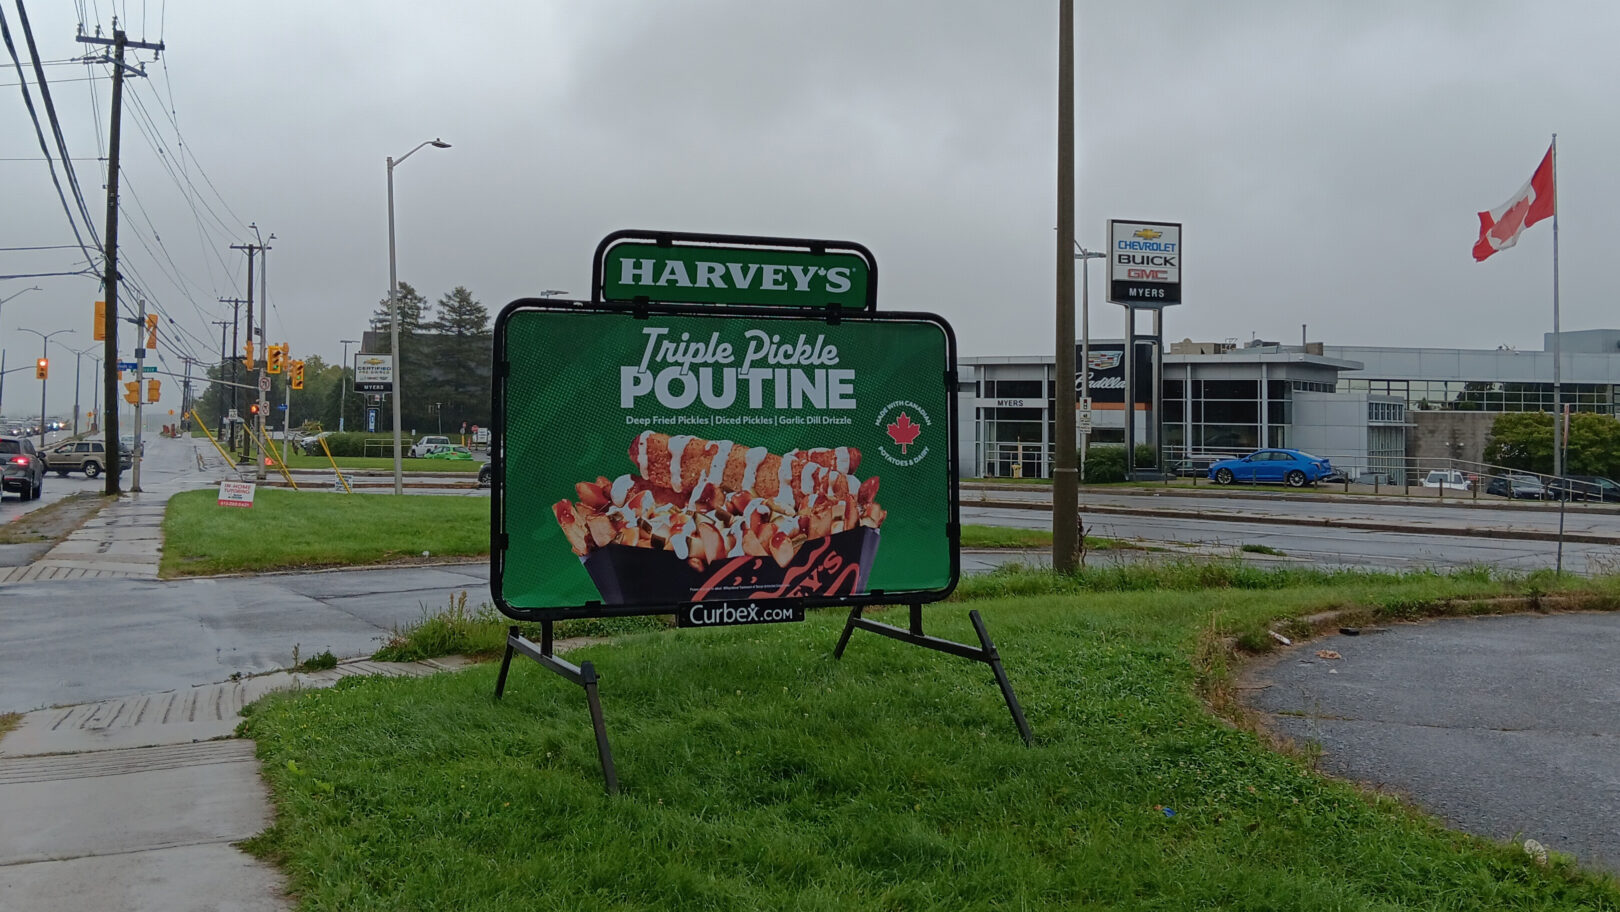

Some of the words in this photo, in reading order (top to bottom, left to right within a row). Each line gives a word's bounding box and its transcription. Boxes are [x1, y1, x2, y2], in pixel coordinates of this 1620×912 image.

[1118, 240, 1176, 252] CHEVROLET
[1118, 254, 1176, 267] BUICK
[618, 257, 851, 293] HARVEY'S
[1128, 268, 1168, 280] GMC
[1129, 287, 1165, 298] MYERS
[637, 327, 735, 375] Triple
[740, 329, 839, 375] Pickle
[620, 365, 857, 409] POUTINE
[997, 399, 1024, 407] MYERS
[875, 407, 889, 426] MADE
[887, 400, 904, 410] WITH
[904, 400, 932, 426] CANADIAN
[626, 415, 651, 426] Deep
[653, 415, 676, 425] Fried
[678, 415, 709, 425] Pickles
[715, 415, 740, 425] Diced
[743, 415, 773, 425] Pickles
[780, 415, 806, 425] Garlic
[807, 415, 821, 425] Dill
[822, 415, 852, 425] Drizzle
[878, 446, 909, 467] POTATOES
[913, 446, 929, 463] DAIRY
